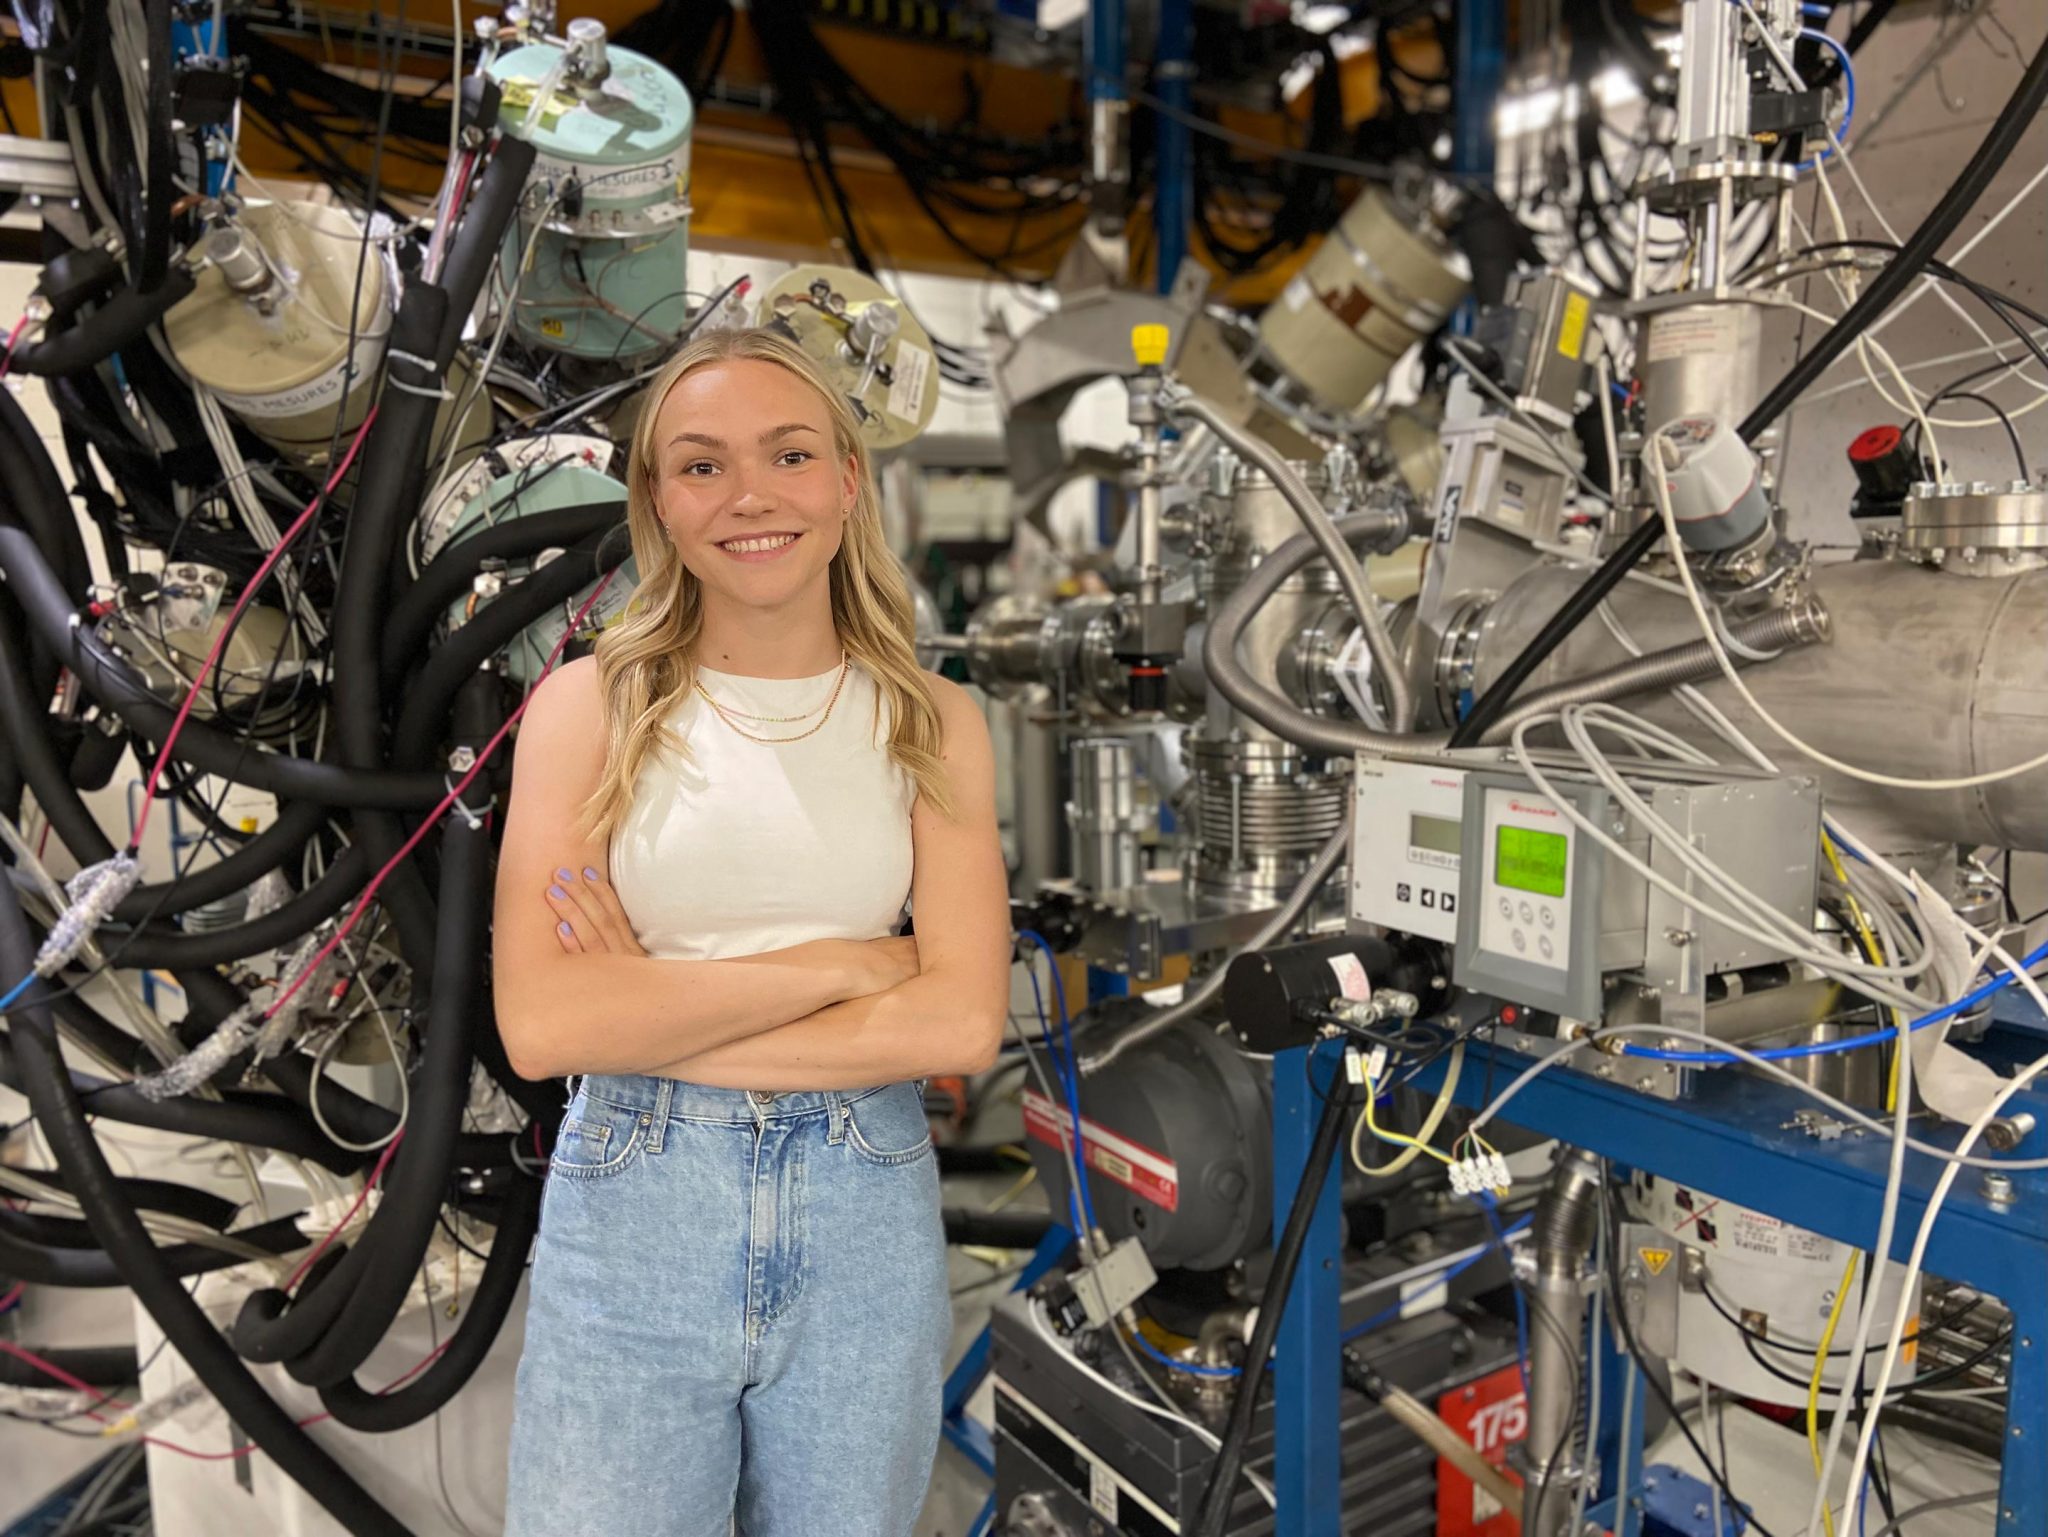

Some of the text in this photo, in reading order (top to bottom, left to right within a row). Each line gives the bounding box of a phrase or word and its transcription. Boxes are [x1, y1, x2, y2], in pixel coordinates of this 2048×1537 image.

[262, 379, 338, 409] MESURES
[1439, 488, 1460, 540] VAT
[1467, 1391, 1527, 1453] 175
